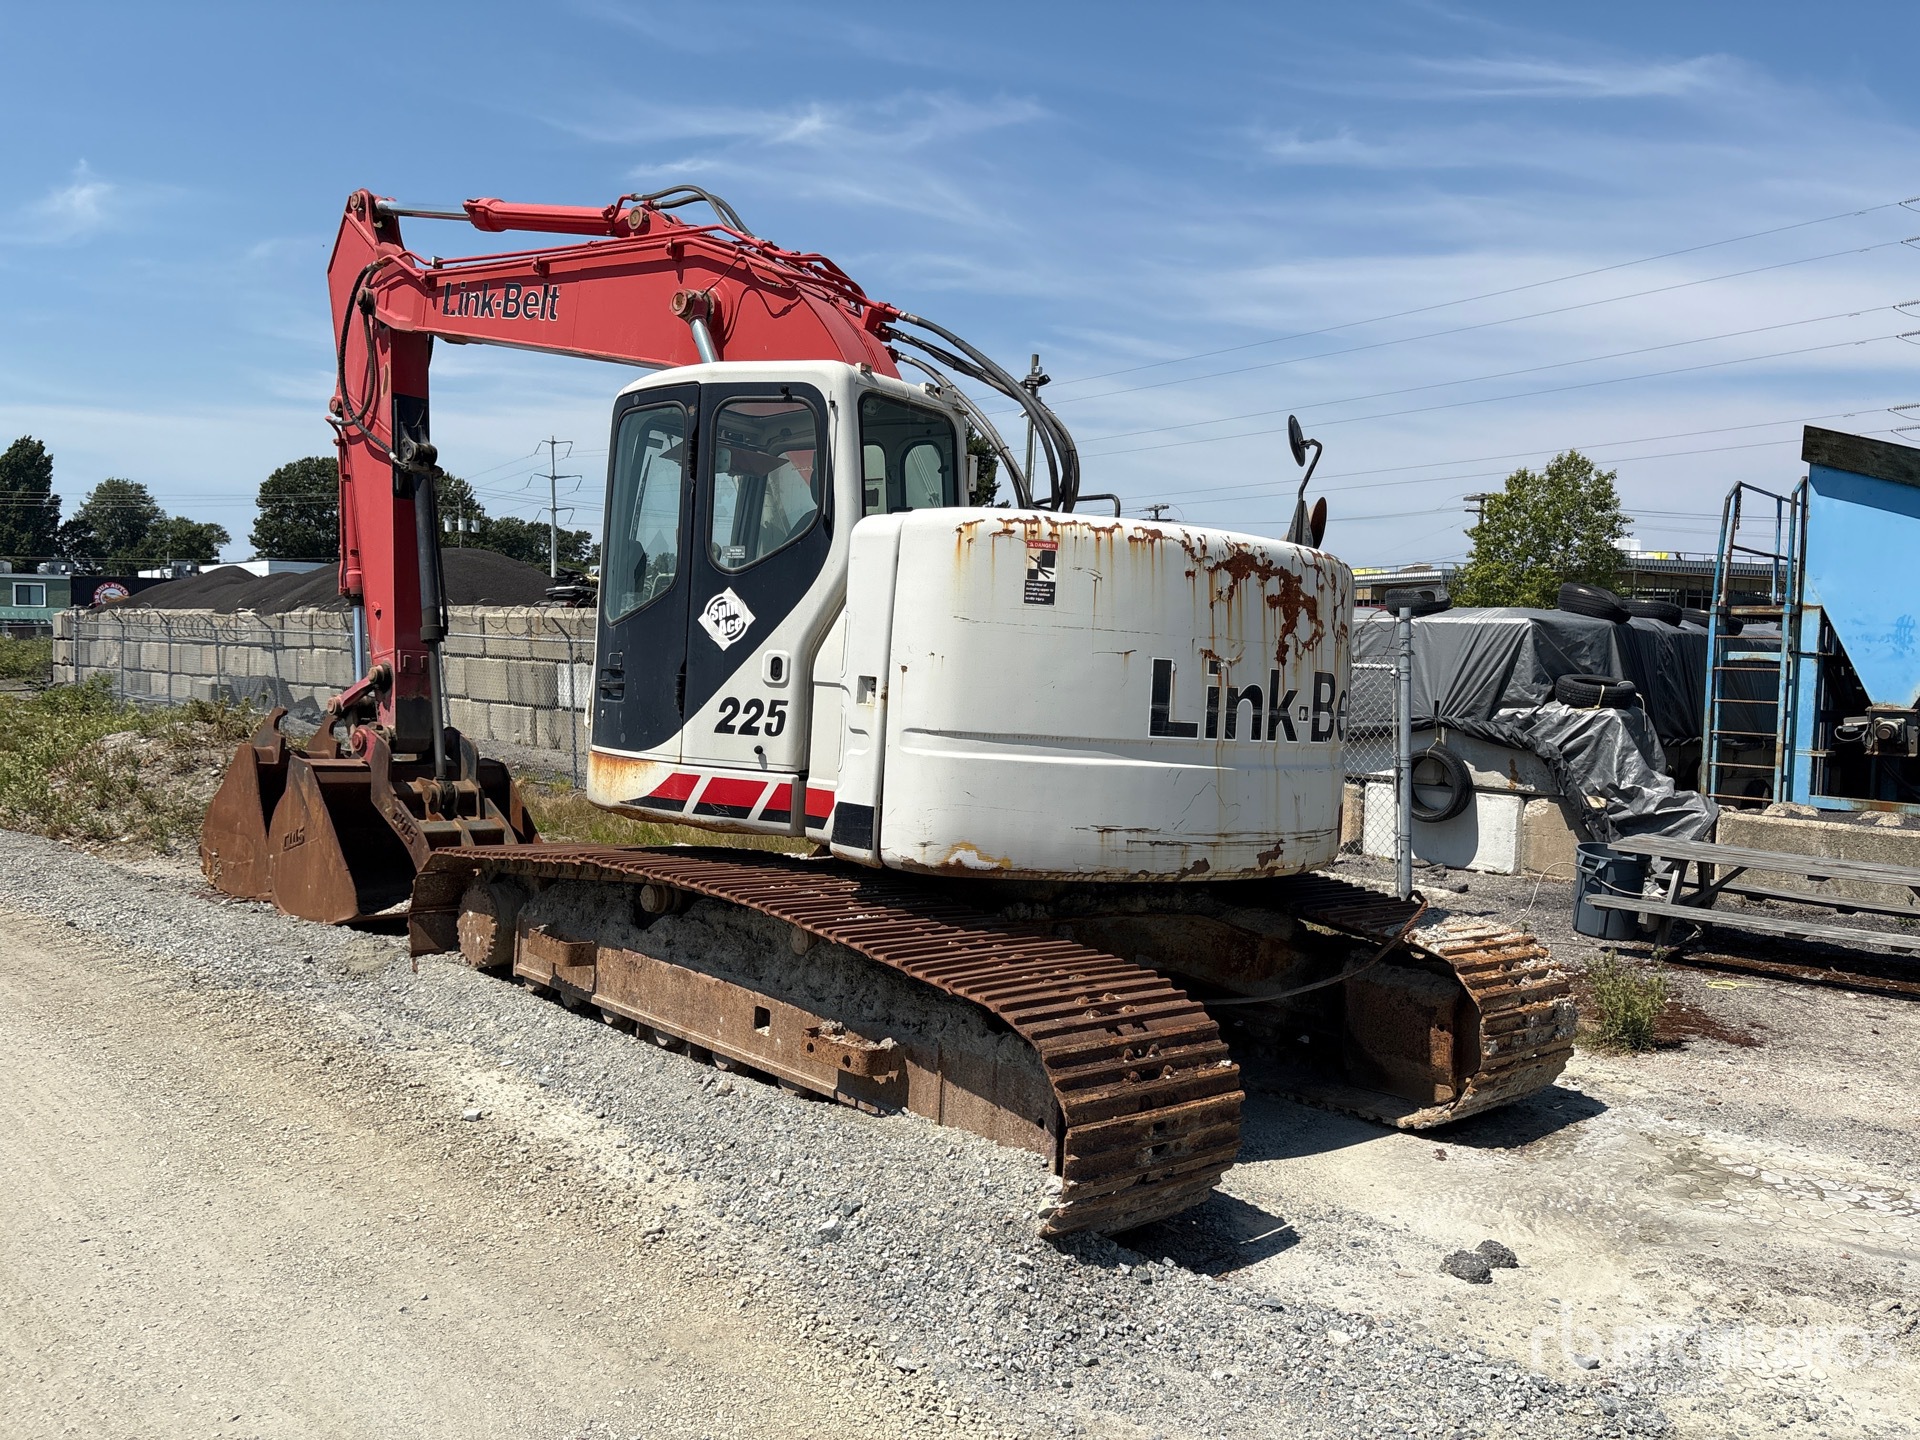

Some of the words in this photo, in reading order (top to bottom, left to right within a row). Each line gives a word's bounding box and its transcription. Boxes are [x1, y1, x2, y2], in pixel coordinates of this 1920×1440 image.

[110, 583, 129, 595] AUTO
[710, 601, 739, 620] Spin
[719, 617, 743, 635] Ace
[714, 697, 789, 737] 225
